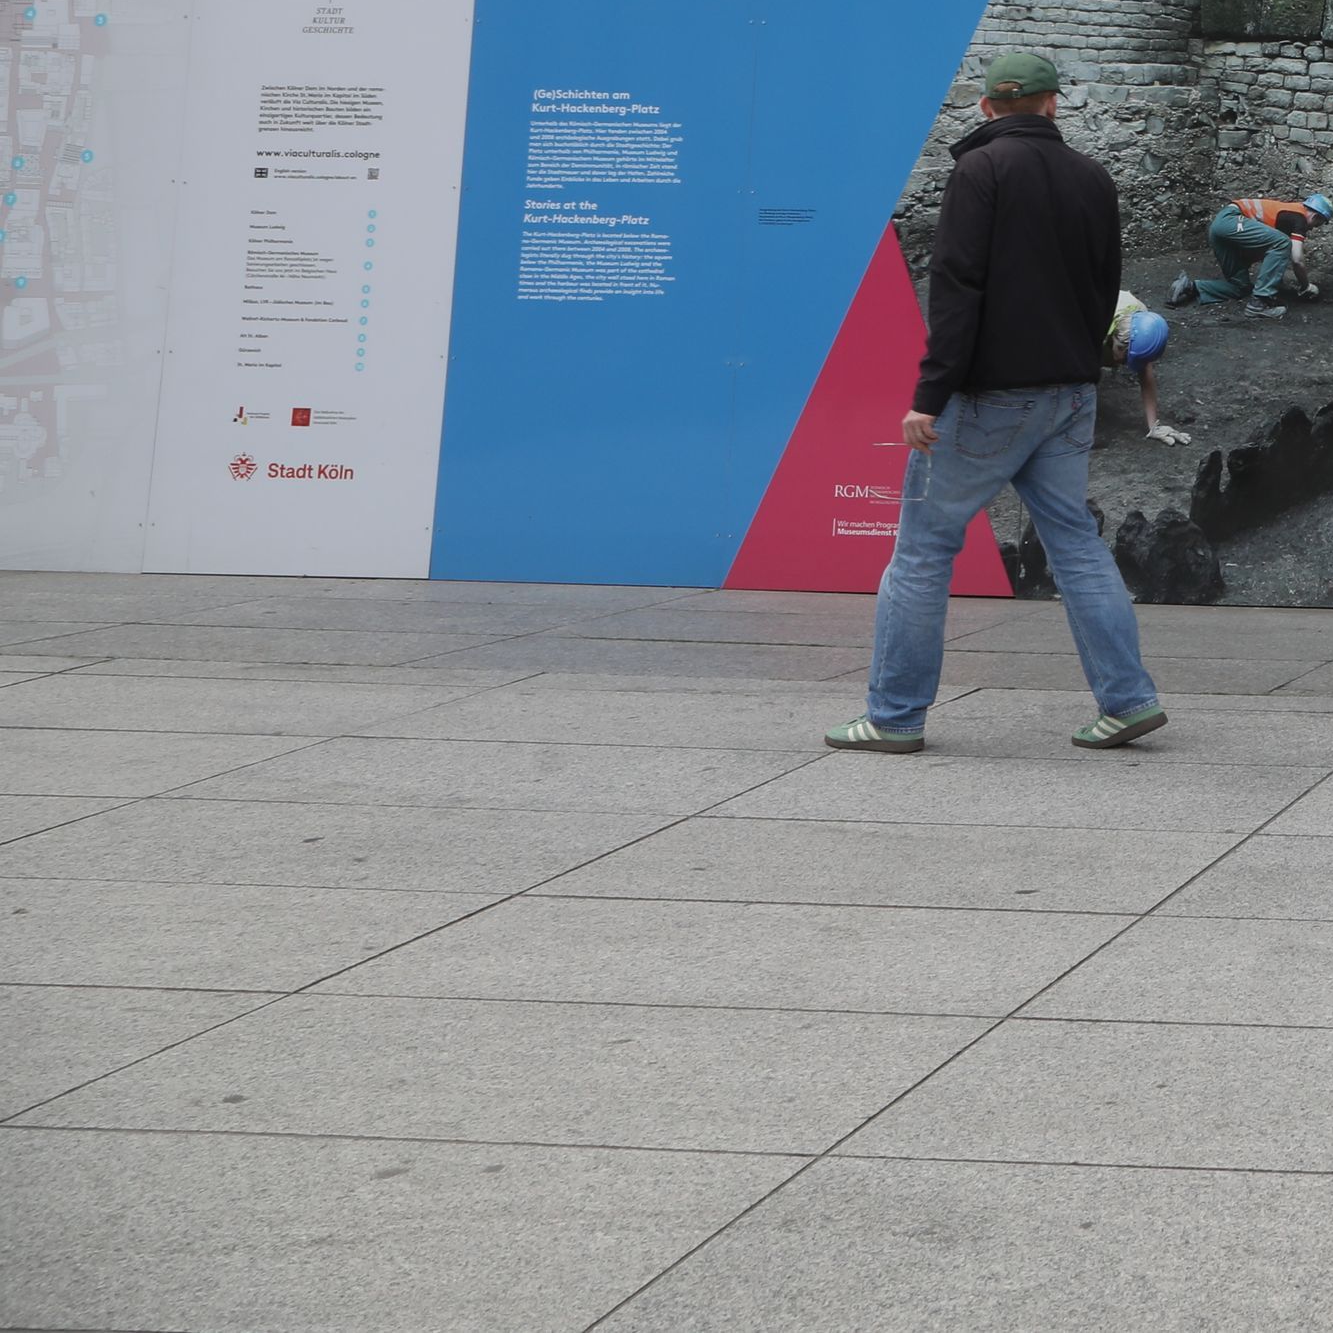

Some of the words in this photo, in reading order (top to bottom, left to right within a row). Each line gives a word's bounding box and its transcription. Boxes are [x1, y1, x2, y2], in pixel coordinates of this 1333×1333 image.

[316, 7, 343, 15] STADT
[302, 26, 354, 34] GESCHICHTE
[533, 89, 609, 99] (Ge)Schichten
[532, 103, 660, 116] Kurt-Hackenberg-Platz
[256, 149, 380, 161] www.viaculturalis.cologne
[524, 200, 561, 209] Stories
[563, 202, 577, 210] at
[579, 201, 598, 210] the
[523, 213, 650, 227] Kurt-Hackenberg-Platz
[268, 463, 314, 479] Stadt
[318, 464, 354, 480] Köln
[835, 485, 869, 498] RGM
[837, 528, 892, 536] Museumsdienst
